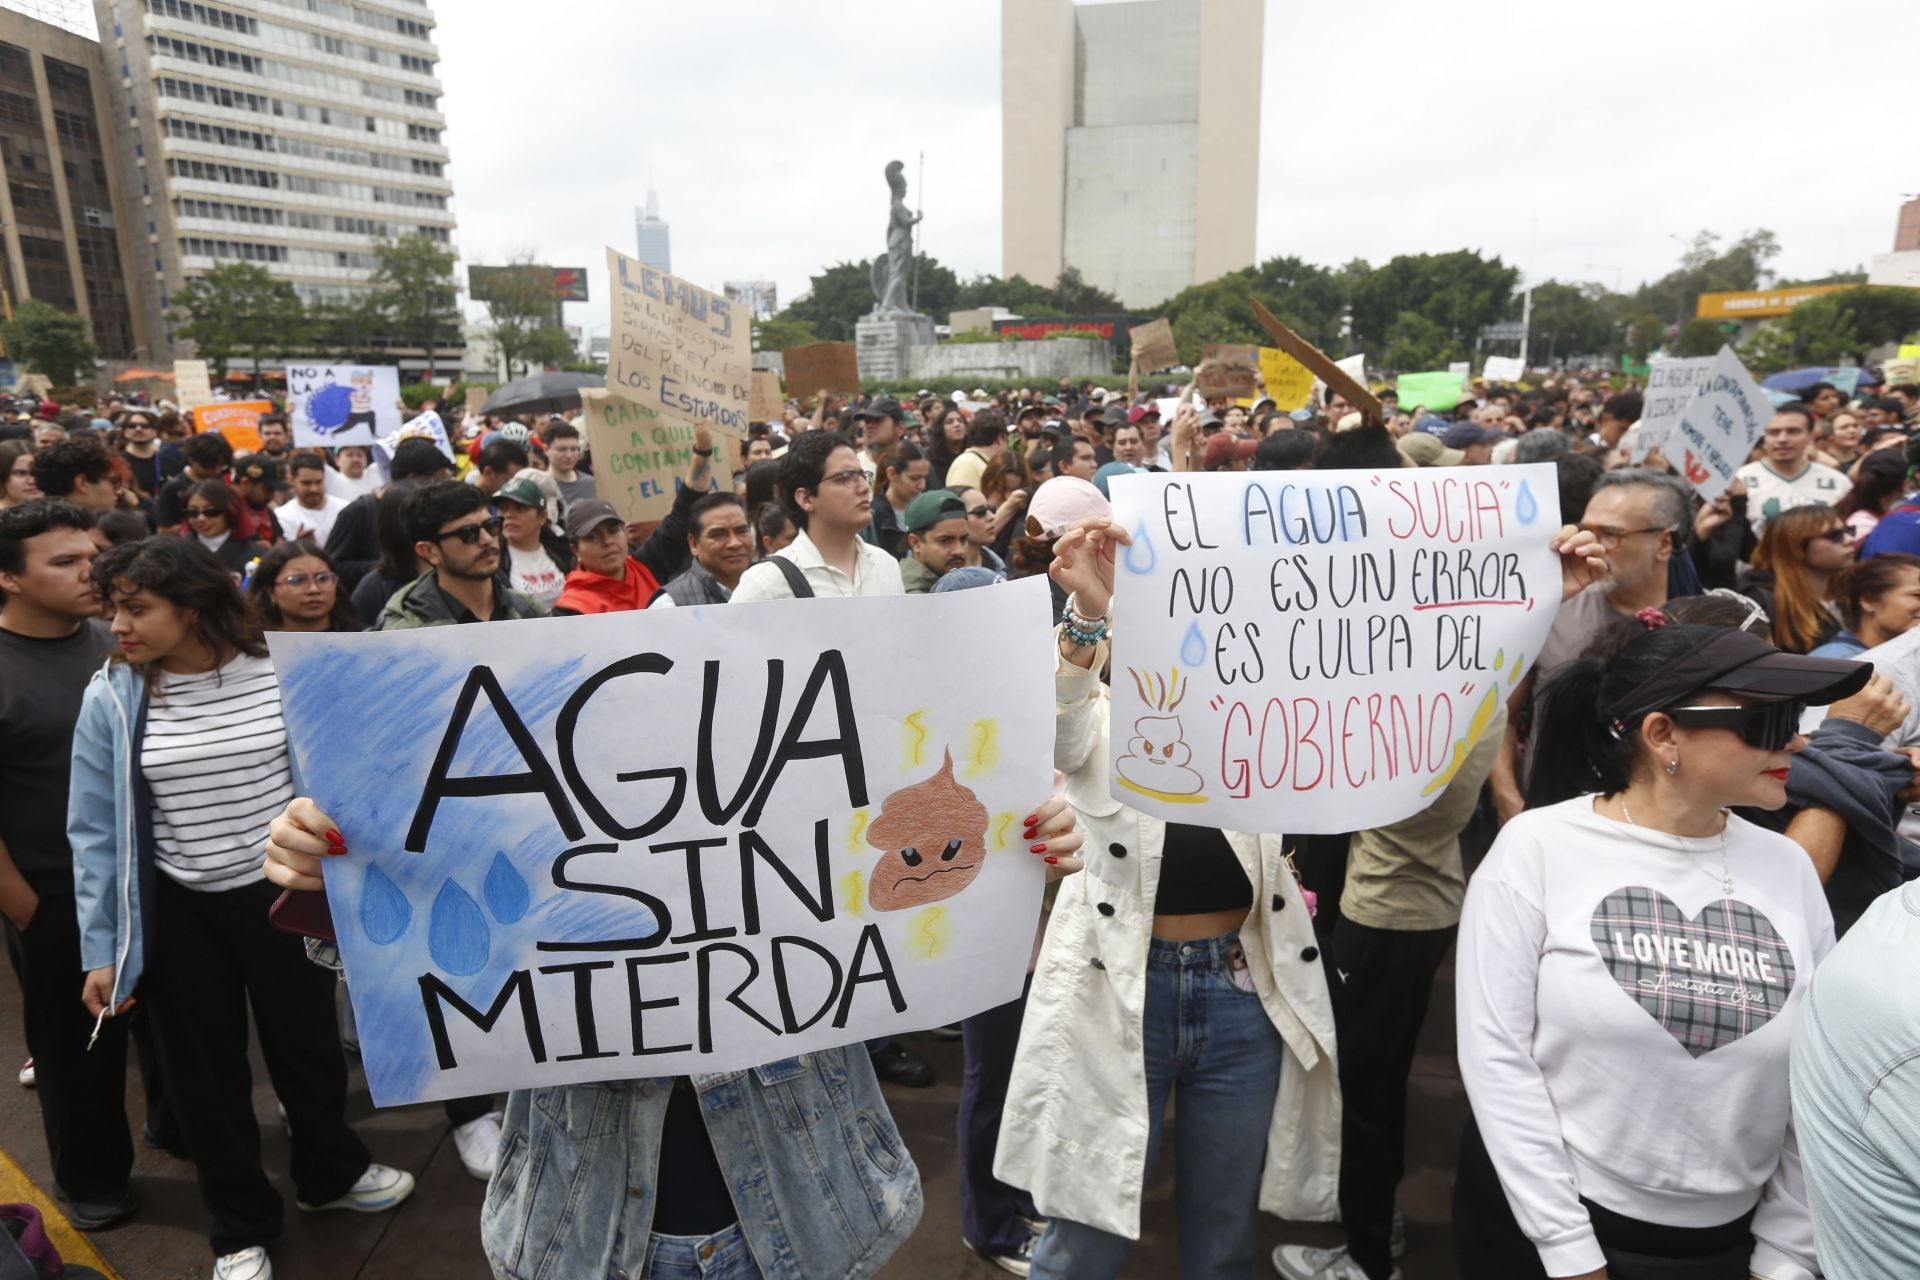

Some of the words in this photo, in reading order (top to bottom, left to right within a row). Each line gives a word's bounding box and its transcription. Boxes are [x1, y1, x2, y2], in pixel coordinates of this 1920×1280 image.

[617, 255, 733, 338] LEMUS
[291, 367, 317, 379] NO
[324, 368, 335, 378] A
[616, 360, 652, 391] LOS
[622, 333, 654, 361] DEL
[291, 384, 312, 396] LA
[610, 446, 723, 475] CONTAME
[631, 431, 644, 447] A
[640, 478, 664, 499] EL
[1163, 481, 1220, 552] EL
[1244, 482, 1368, 546] AGUA
[1370, 475, 1511, 543] "SUCIA"
[1168, 565, 1234, 618] NO
[1270, 553, 1318, 613] ES
[1328, 547, 1396, 609] UN
[1411, 548, 1535, 611] ERROR,
[1214, 621, 1265, 686] ES
[1288, 614, 1413, 682] CULPA
[1435, 613, 1487, 672] DEL
[404, 649, 870, 854] AGUA
[1209, 681, 1476, 799] "GOBIERNO"
[536, 818, 836, 952] SIN
[1614, 931, 1692, 969] LOVE
[1692, 938, 1778, 984] MORE
[416, 923, 908, 1071] MIERDA
